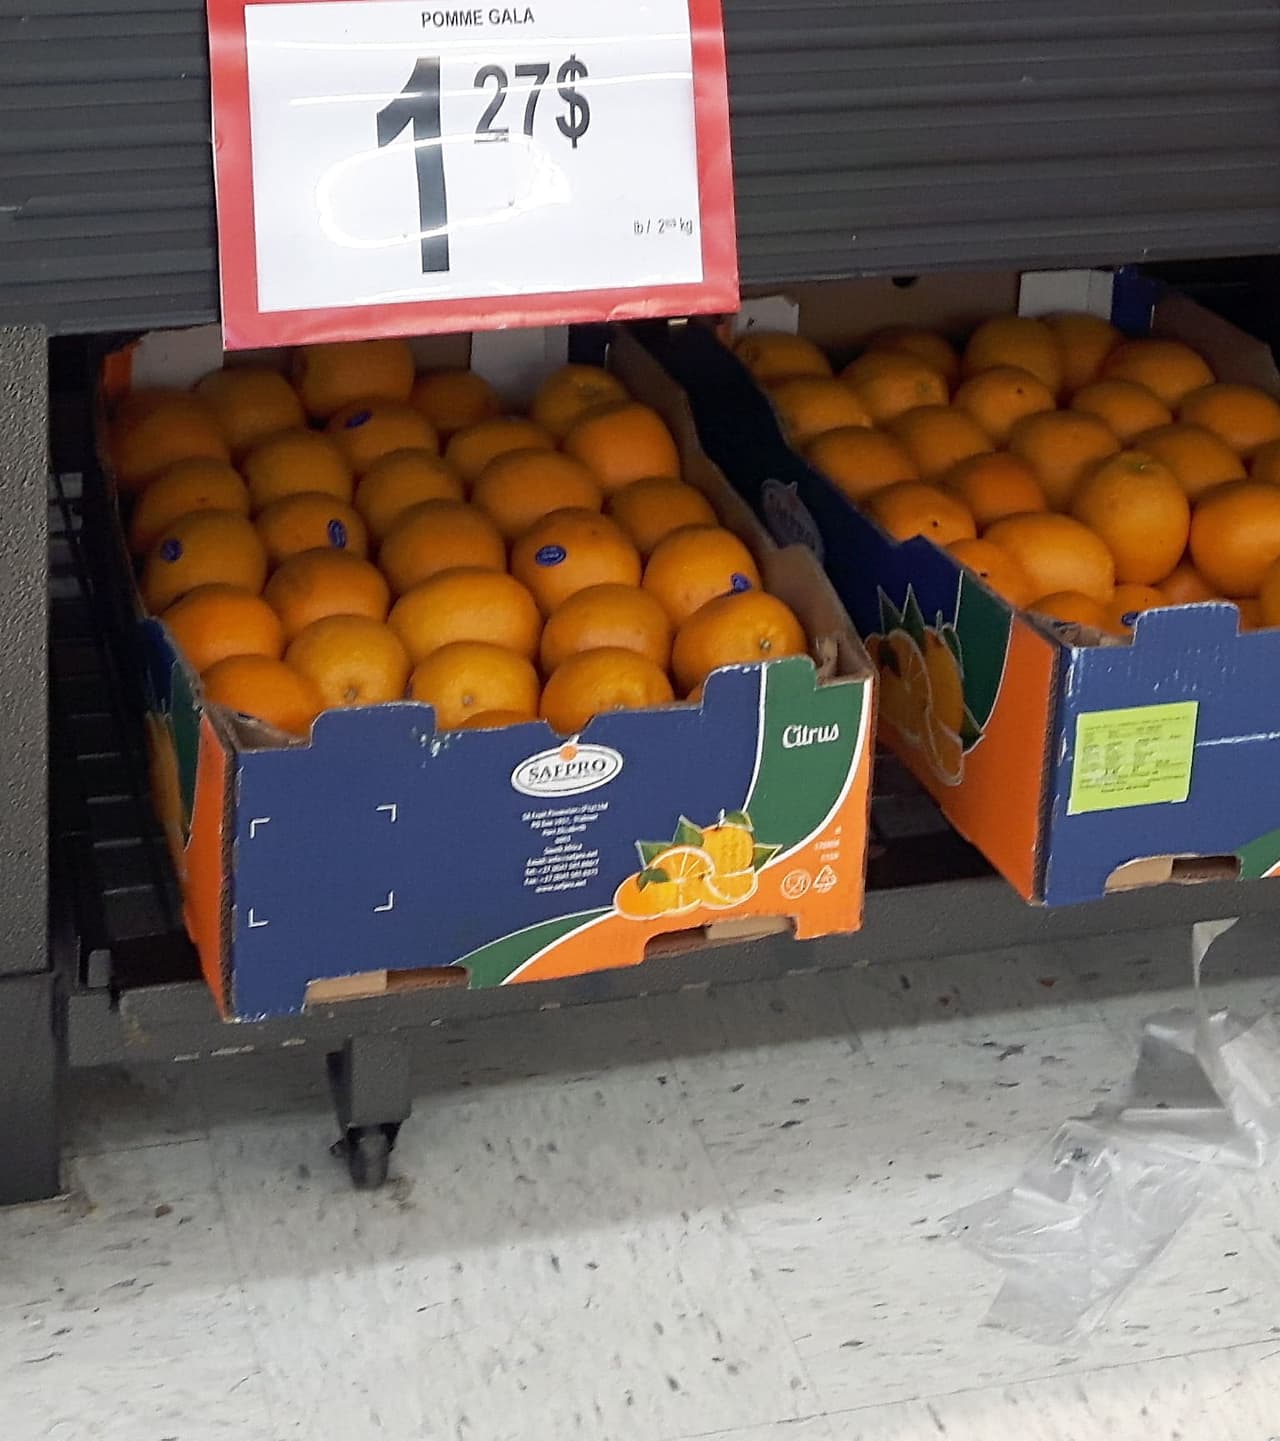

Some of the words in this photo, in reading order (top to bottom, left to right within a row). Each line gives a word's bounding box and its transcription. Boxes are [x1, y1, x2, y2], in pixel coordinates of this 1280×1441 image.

[421, 8, 485, 29] POMME
[488, 6, 536, 27] GALA
[782, 723, 839, 749] Citrus
[527, 758, 608, 782] SAFPRO
